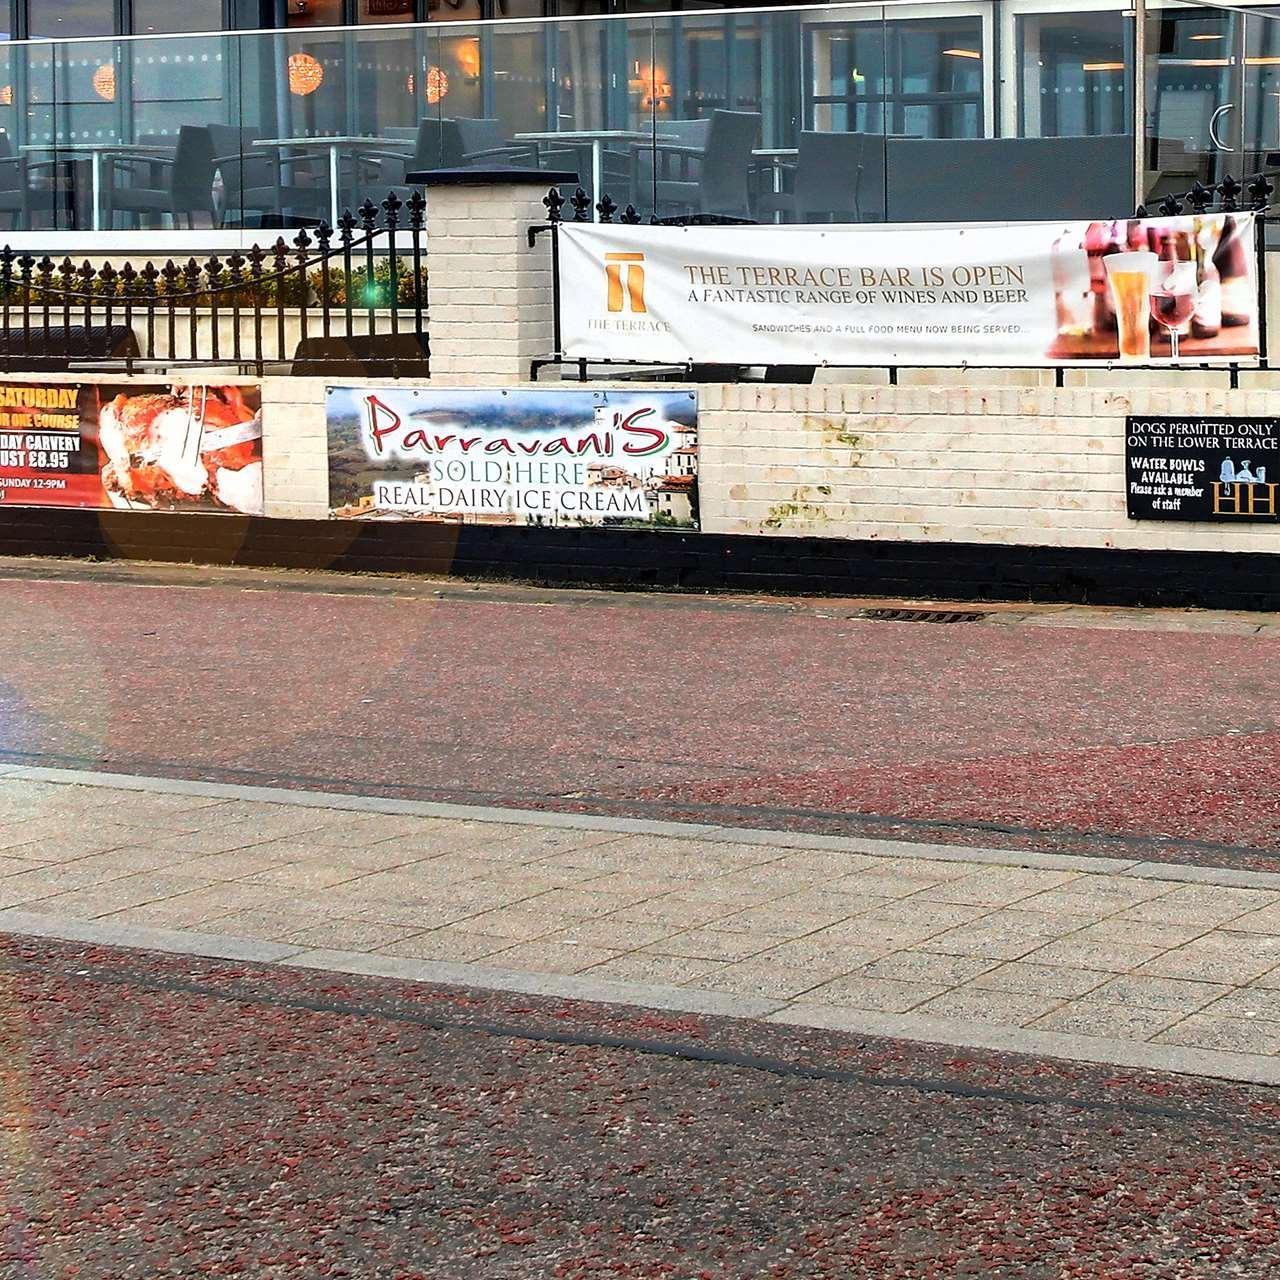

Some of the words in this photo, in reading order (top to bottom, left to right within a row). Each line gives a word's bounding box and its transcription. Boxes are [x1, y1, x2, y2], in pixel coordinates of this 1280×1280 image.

[684, 265, 731, 286] THE
[736, 266, 853, 287] TERRACE
[861, 267, 914, 287] BAR
[922, 266, 945, 287] IS
[952, 265, 1026, 286] OPEN
[687, 289, 698, 303] A
[703, 289, 791, 304] FANTASTIC
[795, 290, 853, 304] RANGE
[856, 290, 877, 304] OF
[881, 290, 937, 304] WINES
[941, 290, 978, 304] AND
[983, 289, 1029, 303] BEER
[587, 319, 610, 330] THE
[616, 320, 672, 332] TERRACE
[752, 323, 812, 334] SANDWICHES
[813, 324, 833, 334] AND
[835, 324, 842, 334] A
[844, 325, 866, 334] FULL
[868, 325, 894, 334] FOOD
[896, 325, 923, 334] MENU
[925, 325, 948, 334] NOW
[951, 325, 981, 334] BEING
[11, 413, 33, 427] ONE
[34, 414, 80, 428] COURSE
[1132, 422, 1167, 435] DOGS
[1170, 423, 1235, 436] PERMITTED
[1237, 424, 1274, 436] ONLY
[25, 436, 80, 451] CARVERY
[1127, 435, 1148, 447] ON
[1151, 436, 1174, 448] THE
[1178, 436, 1220, 449] LOWER
[1223, 437, 1279, 450] TERRACE
[28, 451, 69, 468] £8.95
[1130, 456, 1168, 470] WATER
[1169, 458, 1205, 472] BOWLS
[433, 459, 503, 483] SOLD
[515, 461, 584, 485] HERE
[1141, 471, 1194, 485] AVAILABLE
[33, 478, 66, 489] 12-9PM
[1130, 481, 1152, 495] Please
[1153, 484, 1167, 495] ask
[1167, 487, 1173, 496] a
[1174, 486, 1205, 497] member
[378, 486, 431, 505] REAL
[438, 488, 507, 509] DAIRY
[516, 490, 551, 510] ICE
[560, 491, 643, 512] CREAM
[1152, 497, 1161, 510] of
[1161, 498, 1181, 510] staff
